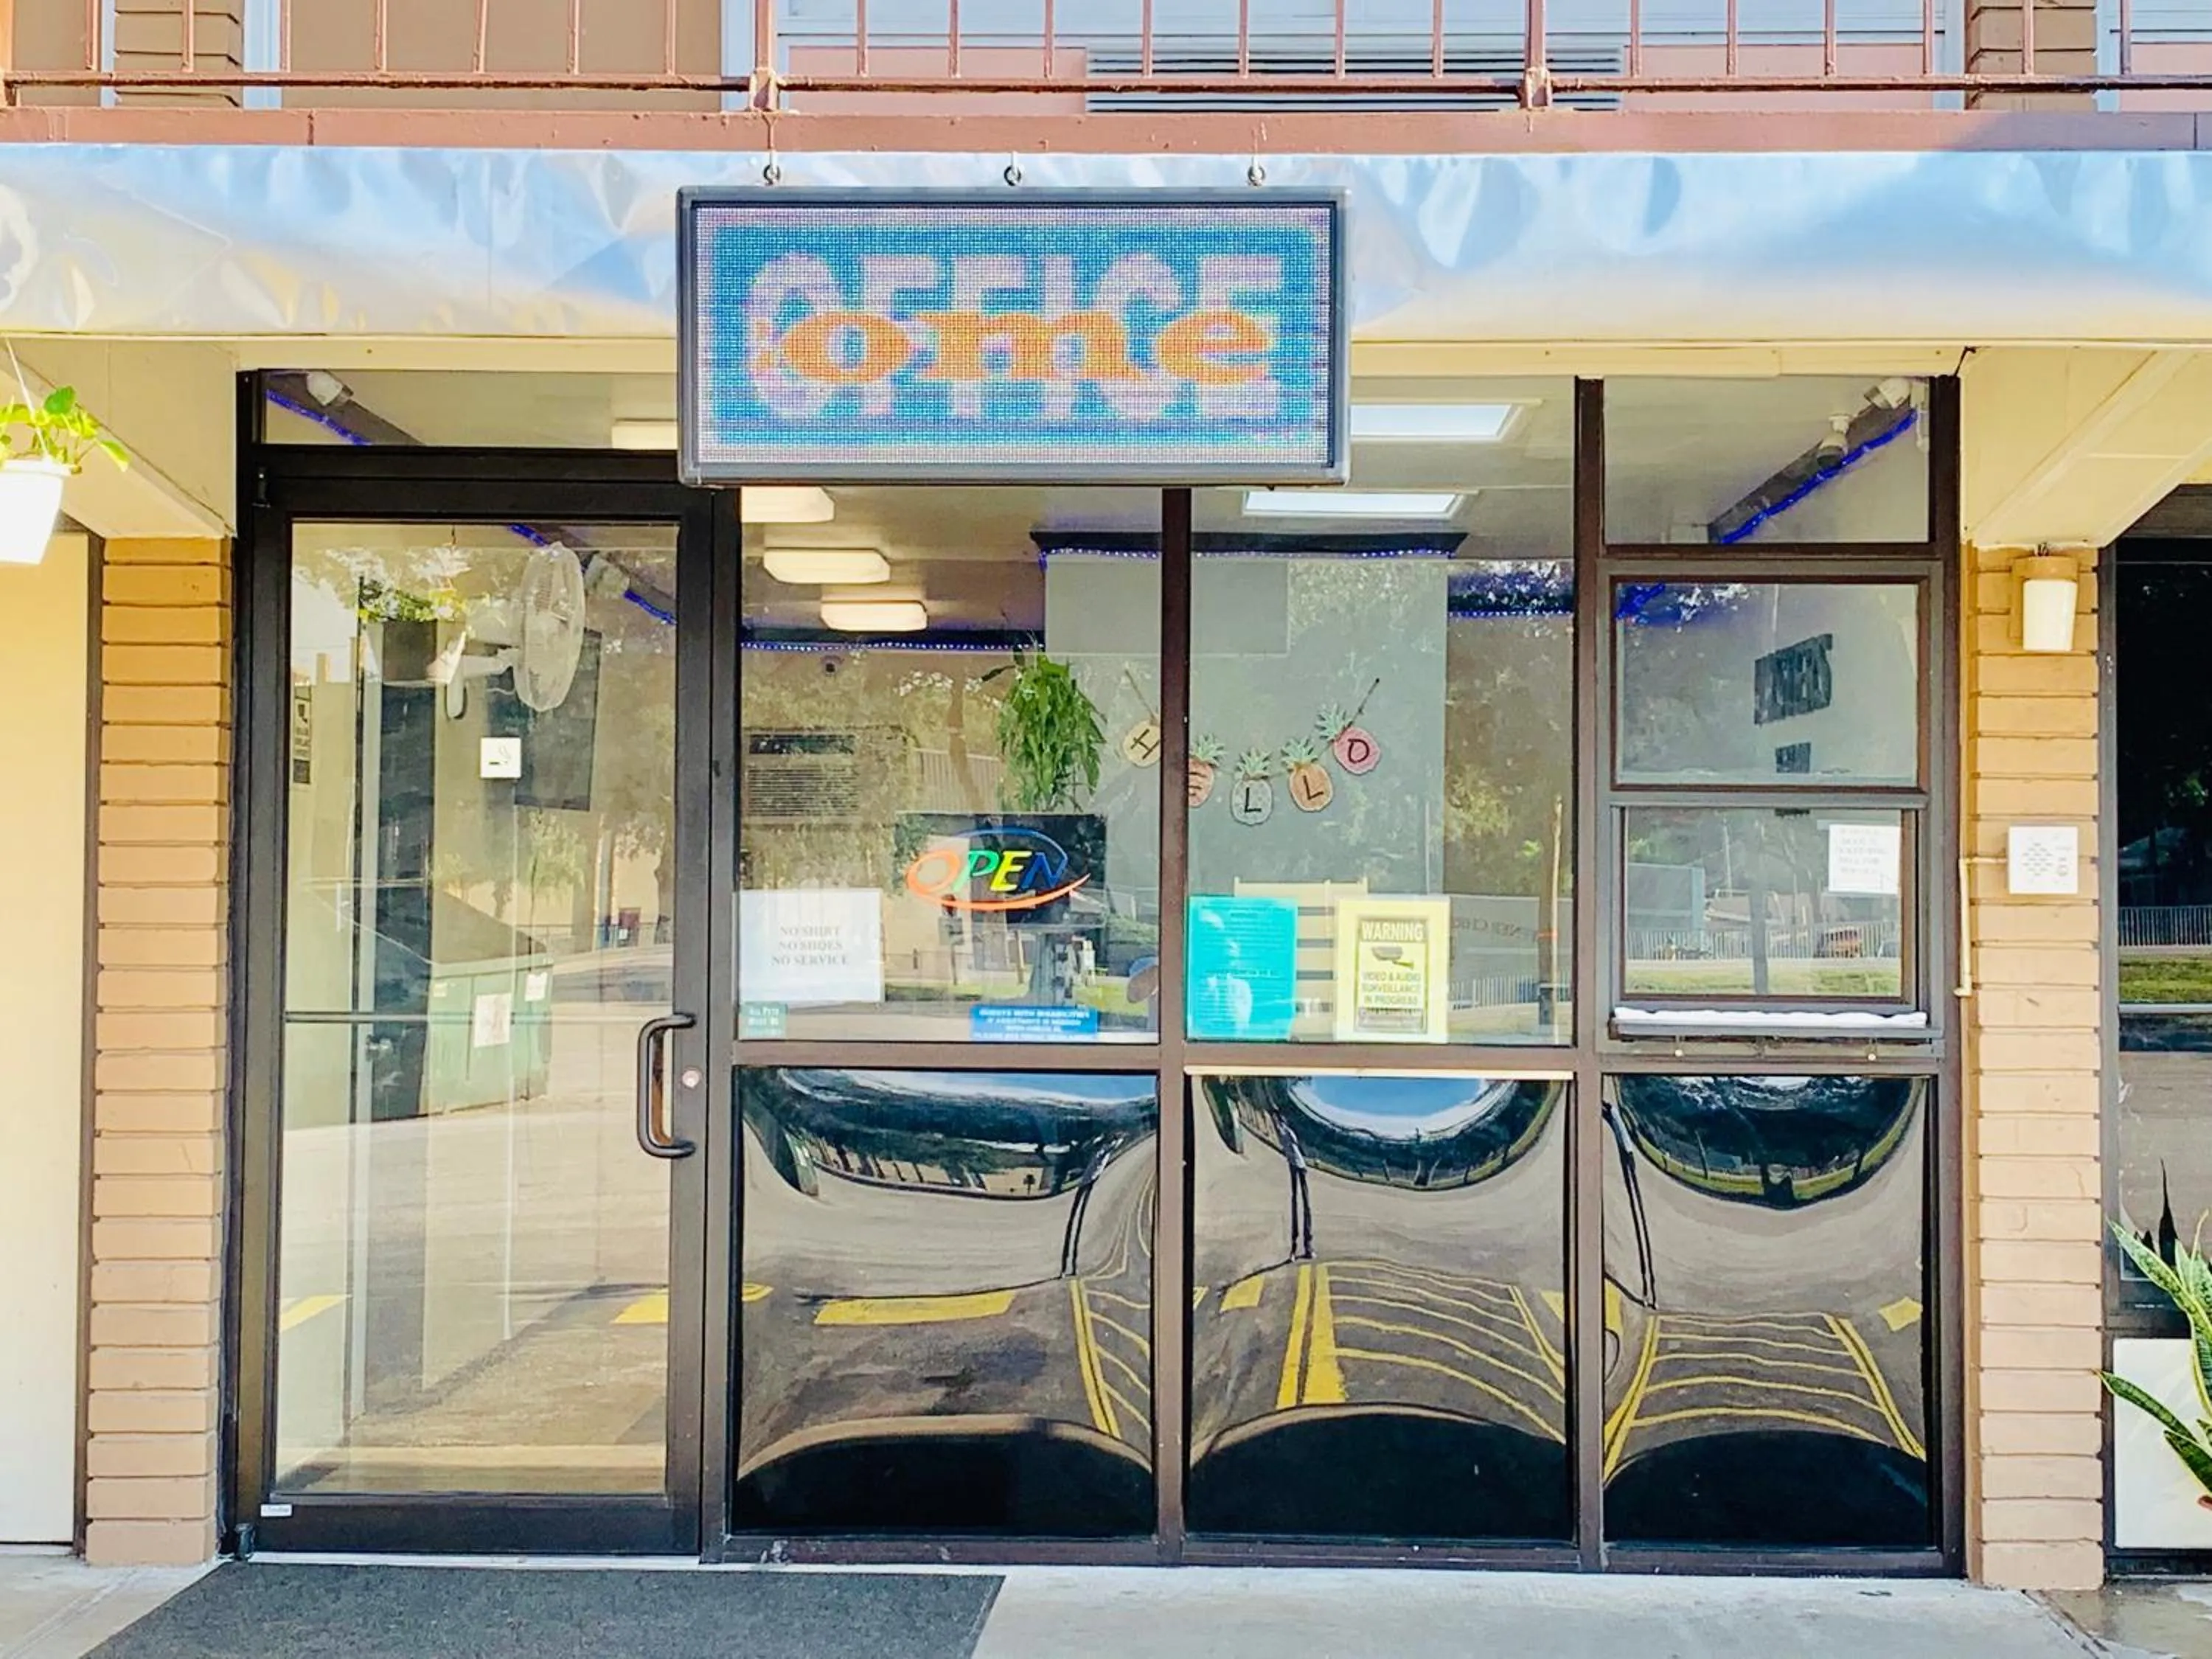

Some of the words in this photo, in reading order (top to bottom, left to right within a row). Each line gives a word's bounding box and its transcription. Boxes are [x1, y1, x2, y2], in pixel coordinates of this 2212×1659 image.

[748, 253, 1283, 421] OFFICE
[906, 849, 1068, 895] OPEN
[780, 925, 799, 936] NO
[801, 925, 841, 937] SHIRT
[1361, 921, 1425, 942] WARNING
[779, 940, 797, 951] NO
[800, 940, 843, 951] SHOES
[771, 954, 790, 966] NO
[794, 954, 849, 967] SERVICE
[1362, 971, 1386, 981] VIDEO
[1396, 971, 1421, 982] AUDIO
[1361, 983, 1421, 993] SURVEILLANCE
[1364, 995, 1372, 1004] IN
[1374, 995, 1418, 1005] PROGRESS
